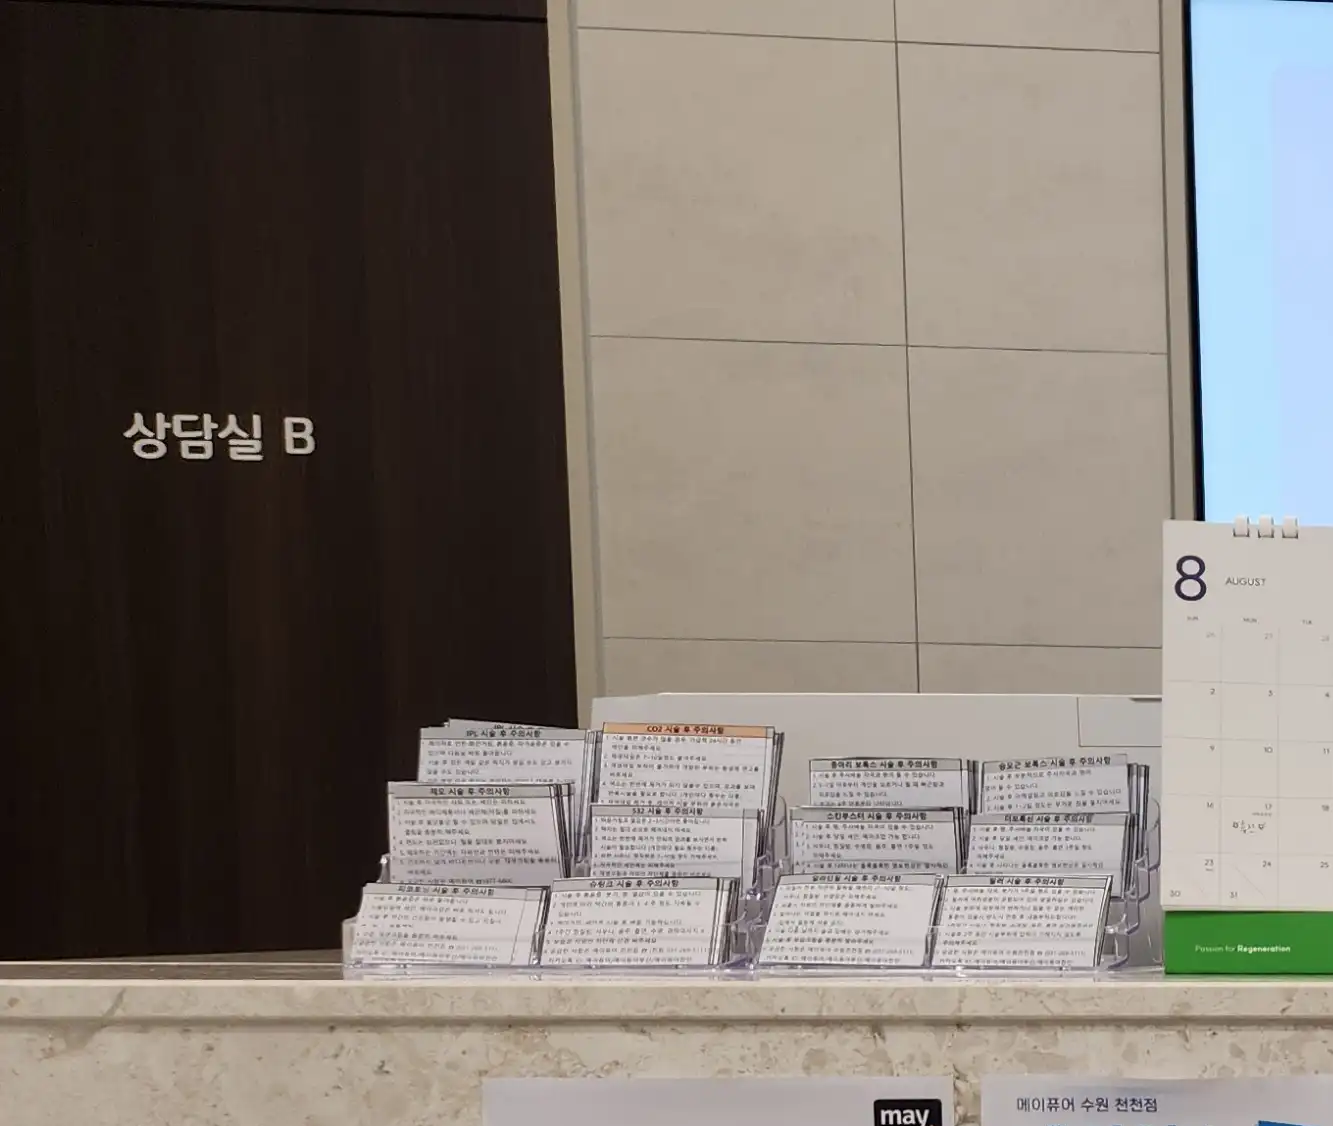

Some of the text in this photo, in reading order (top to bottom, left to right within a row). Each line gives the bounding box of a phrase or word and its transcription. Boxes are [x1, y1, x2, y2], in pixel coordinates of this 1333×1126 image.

[123, 412, 315, 461] 상담실 B
[1175, 555, 1266, 601] 8 AUGUST
[1235, 945, 1290, 954] Regeneration
[1017, 1098, 1157, 1112] 메이퓨어 수원 천천점
